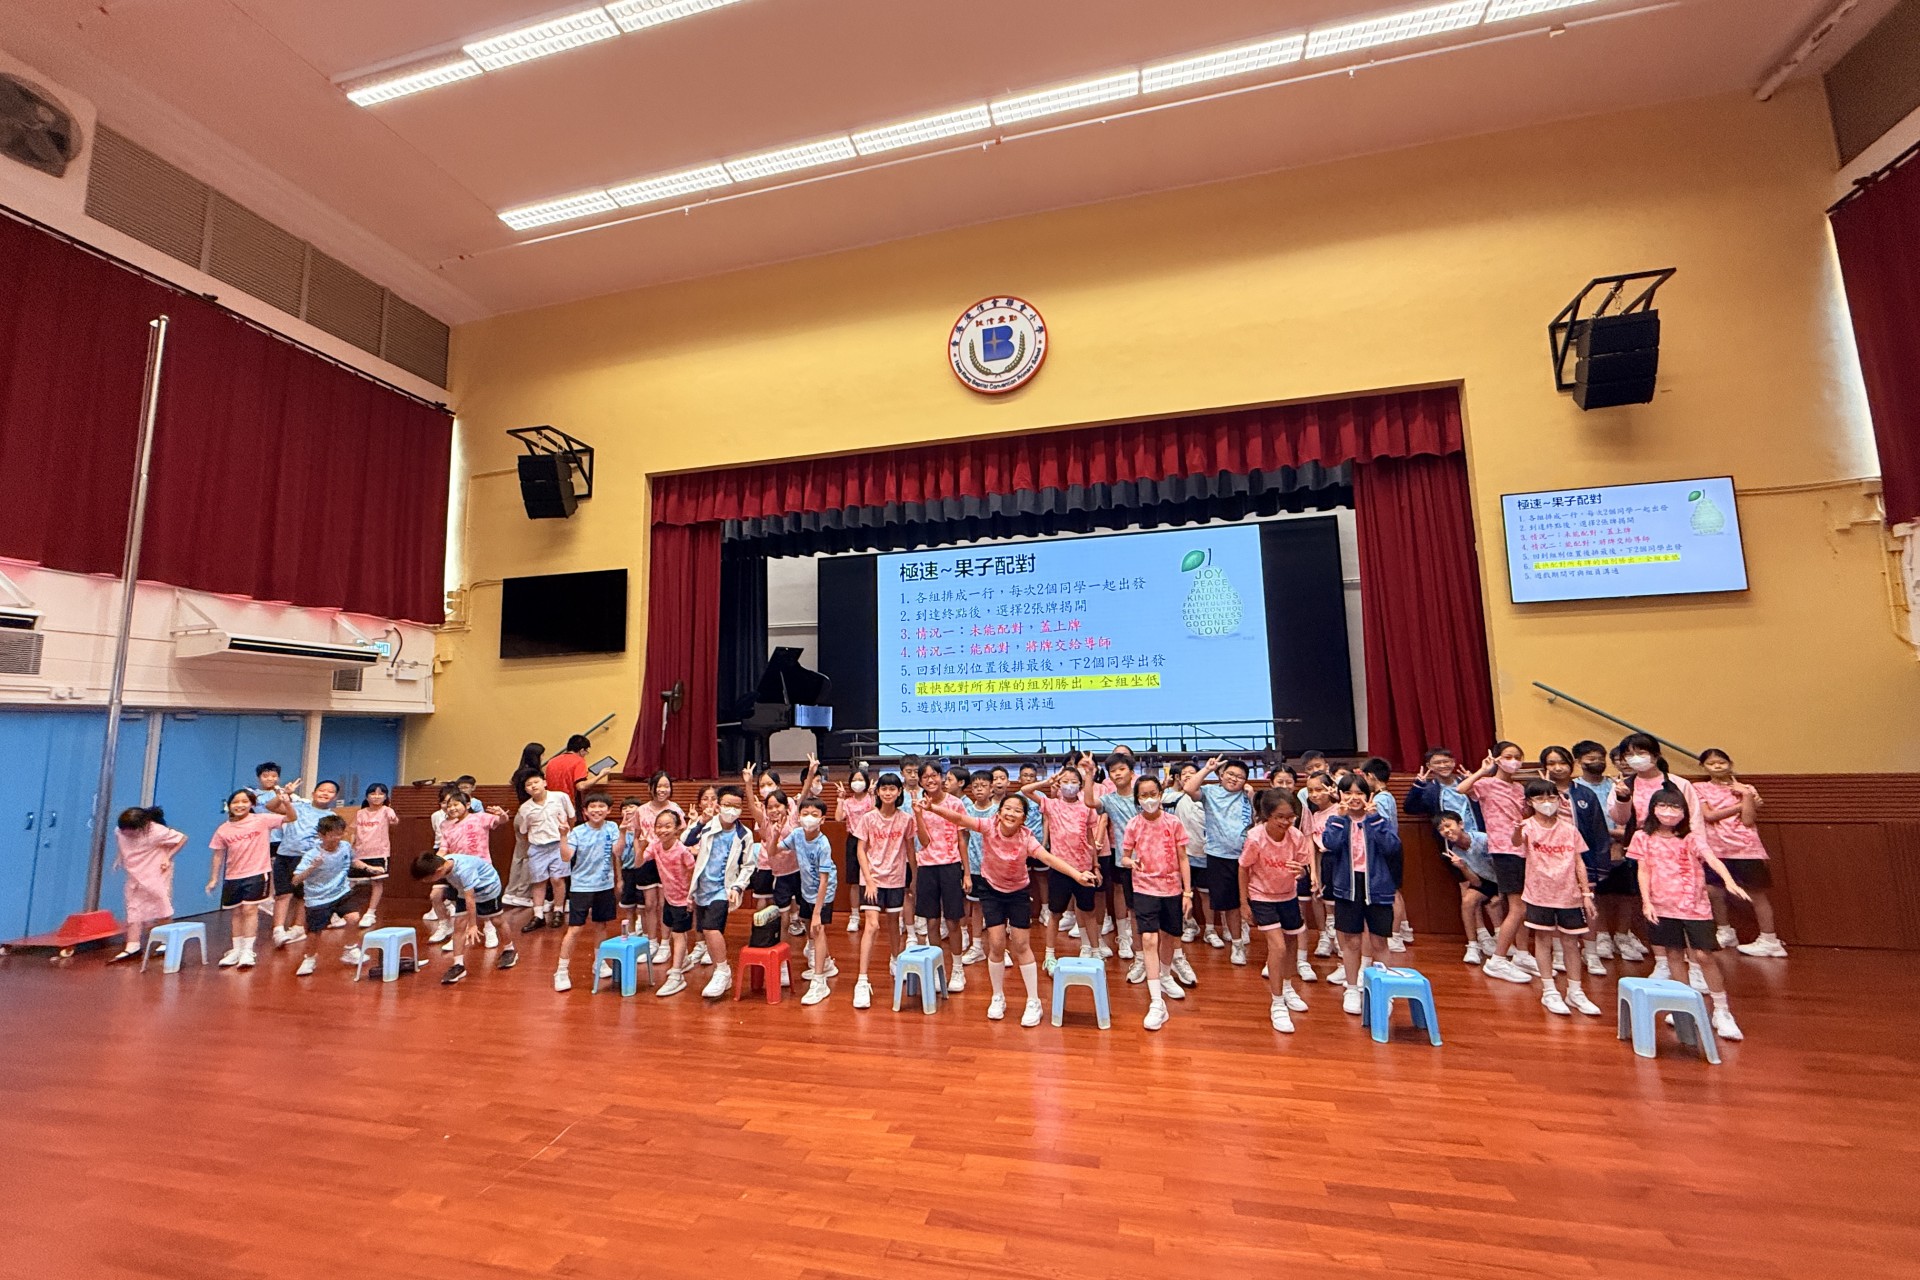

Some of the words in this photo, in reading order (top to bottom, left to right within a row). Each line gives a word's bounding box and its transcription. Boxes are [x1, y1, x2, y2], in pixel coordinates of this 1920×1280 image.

[1195, 568, 1223, 580] JOY
[1193, 579, 1228, 588] PEACE
[1190, 586, 1233, 595] PATIENCE
[1187, 592, 1239, 602] KINDNESS
[1183, 600, 1242, 608] FAITHFULNESS
[1182, 612, 1242, 621] GENTLENESS
[1185, 619, 1240, 628] GOODNESS
[1197, 626, 1229, 636] LOVE
